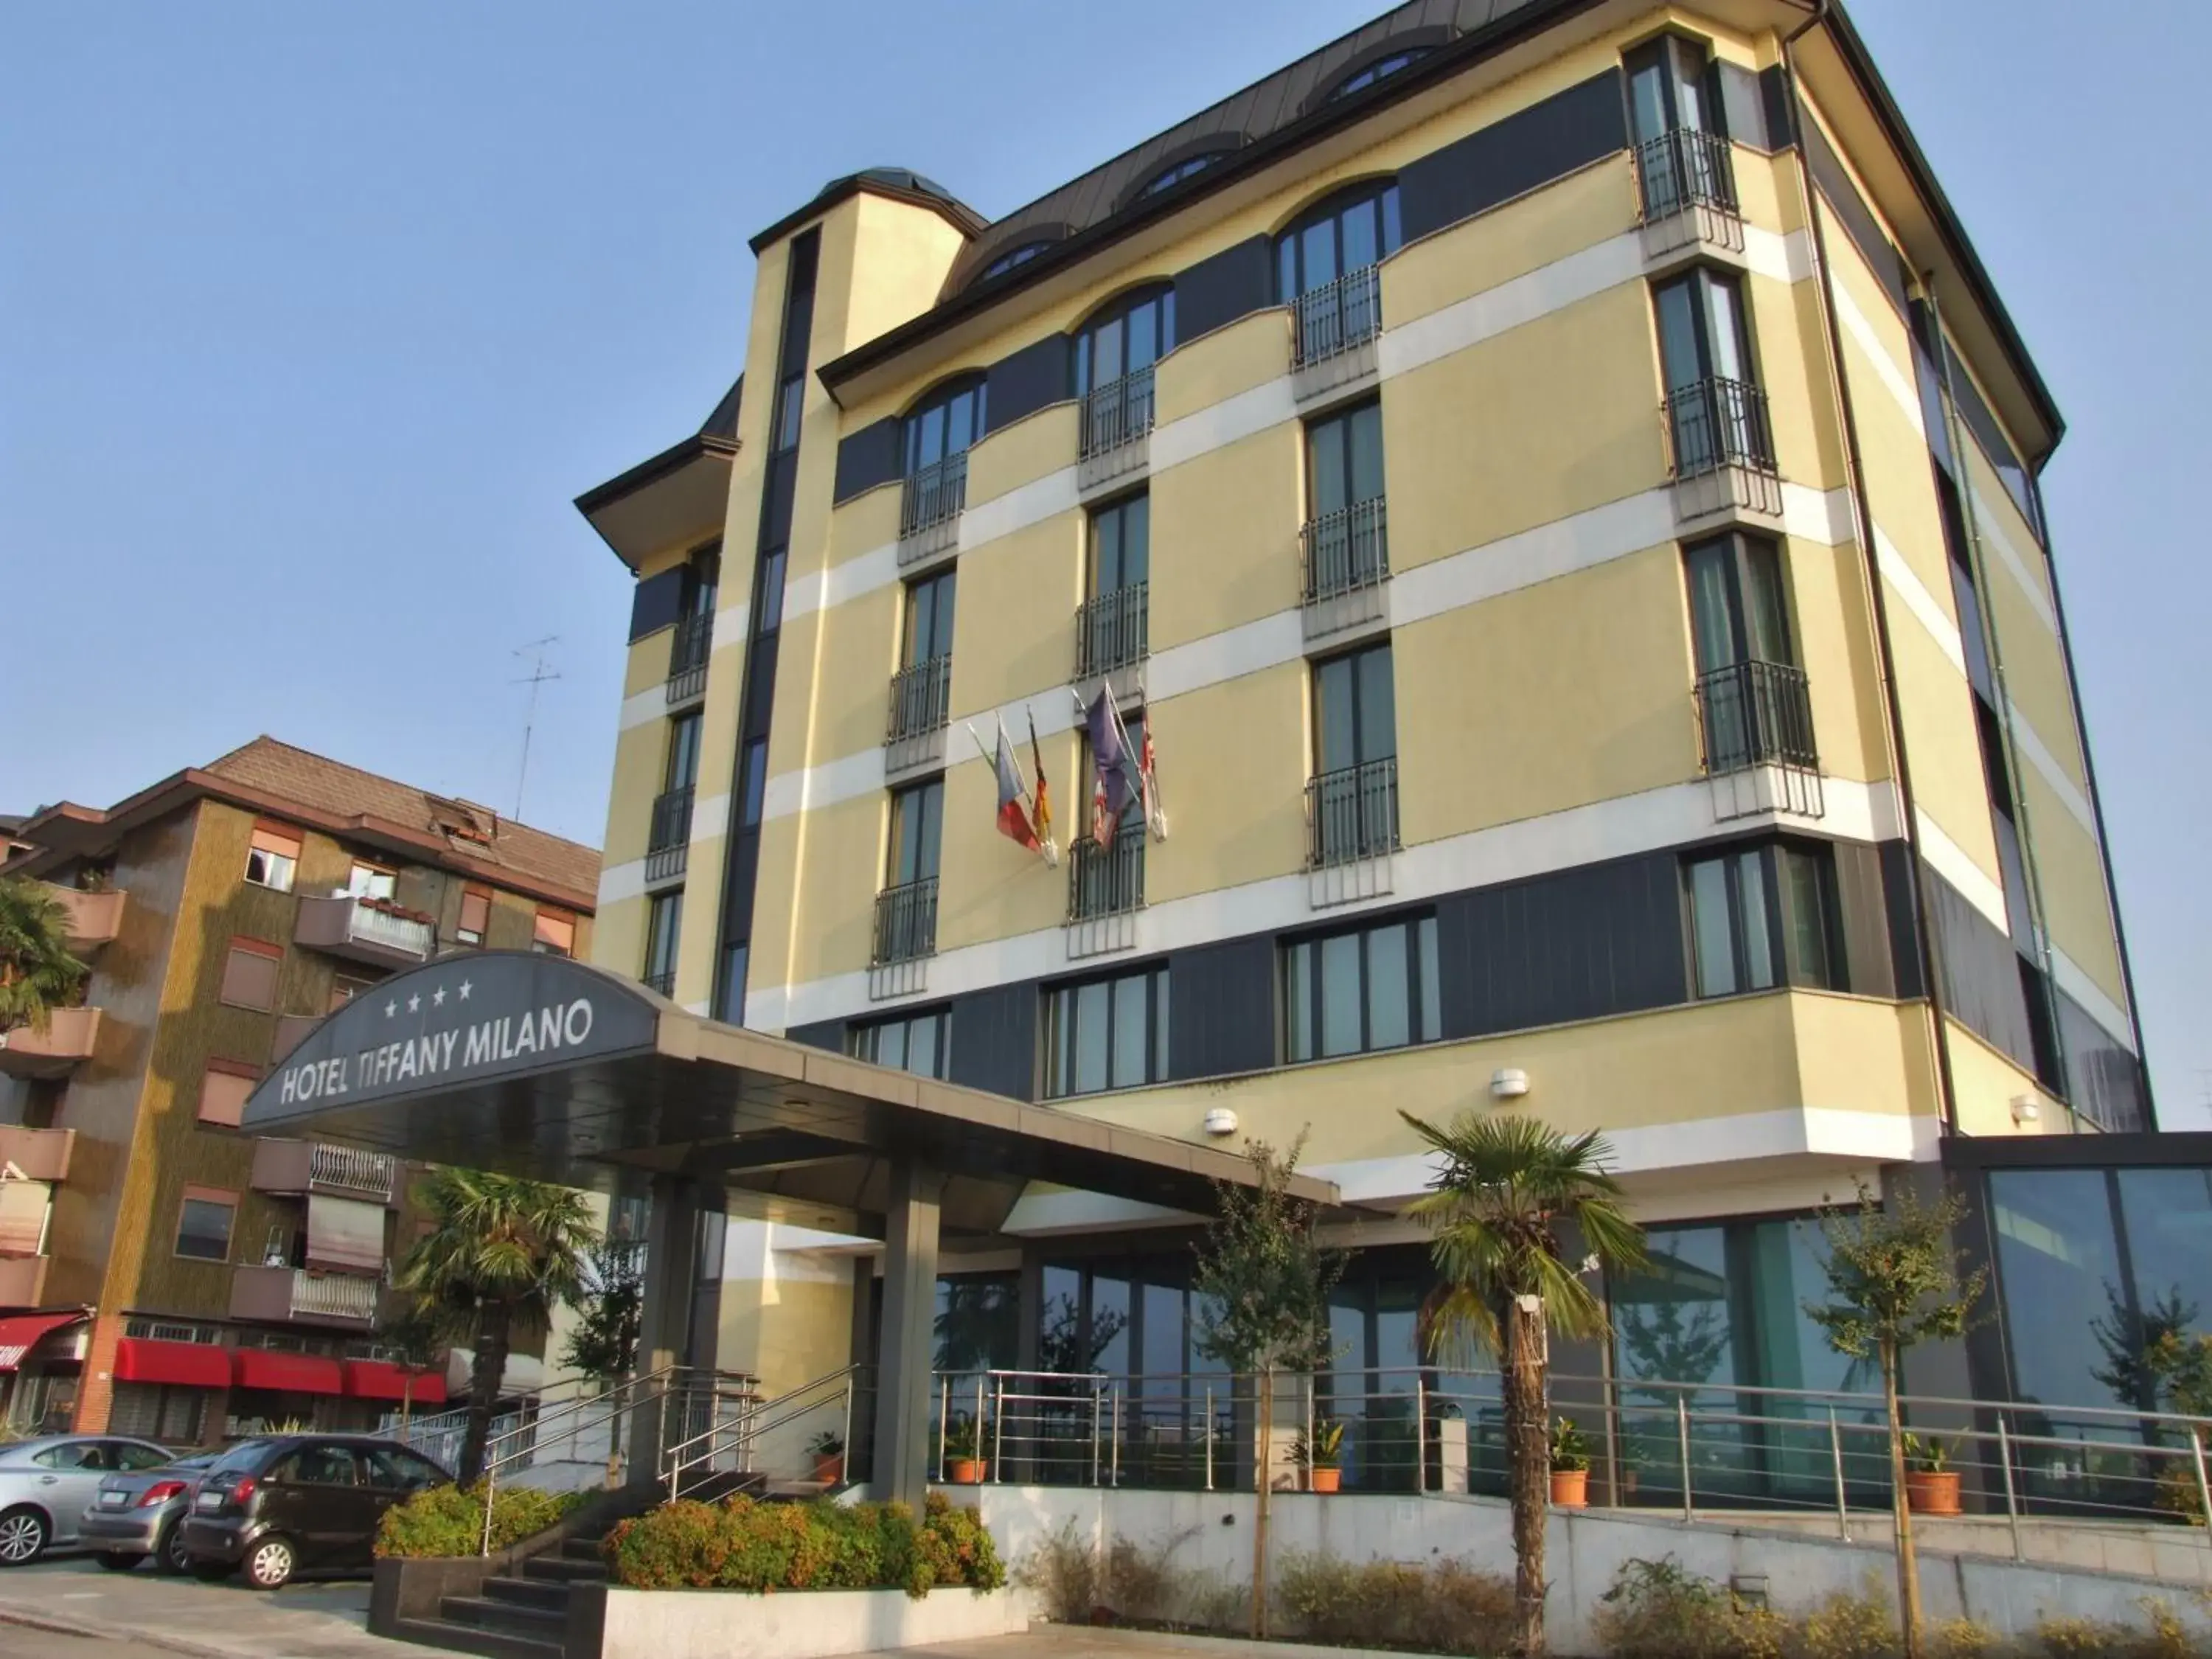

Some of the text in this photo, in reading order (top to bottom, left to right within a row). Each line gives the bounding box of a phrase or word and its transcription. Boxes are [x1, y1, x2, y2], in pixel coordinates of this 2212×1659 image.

[280, 998, 593, 1105] HOTEL TIFFANY MILANO
